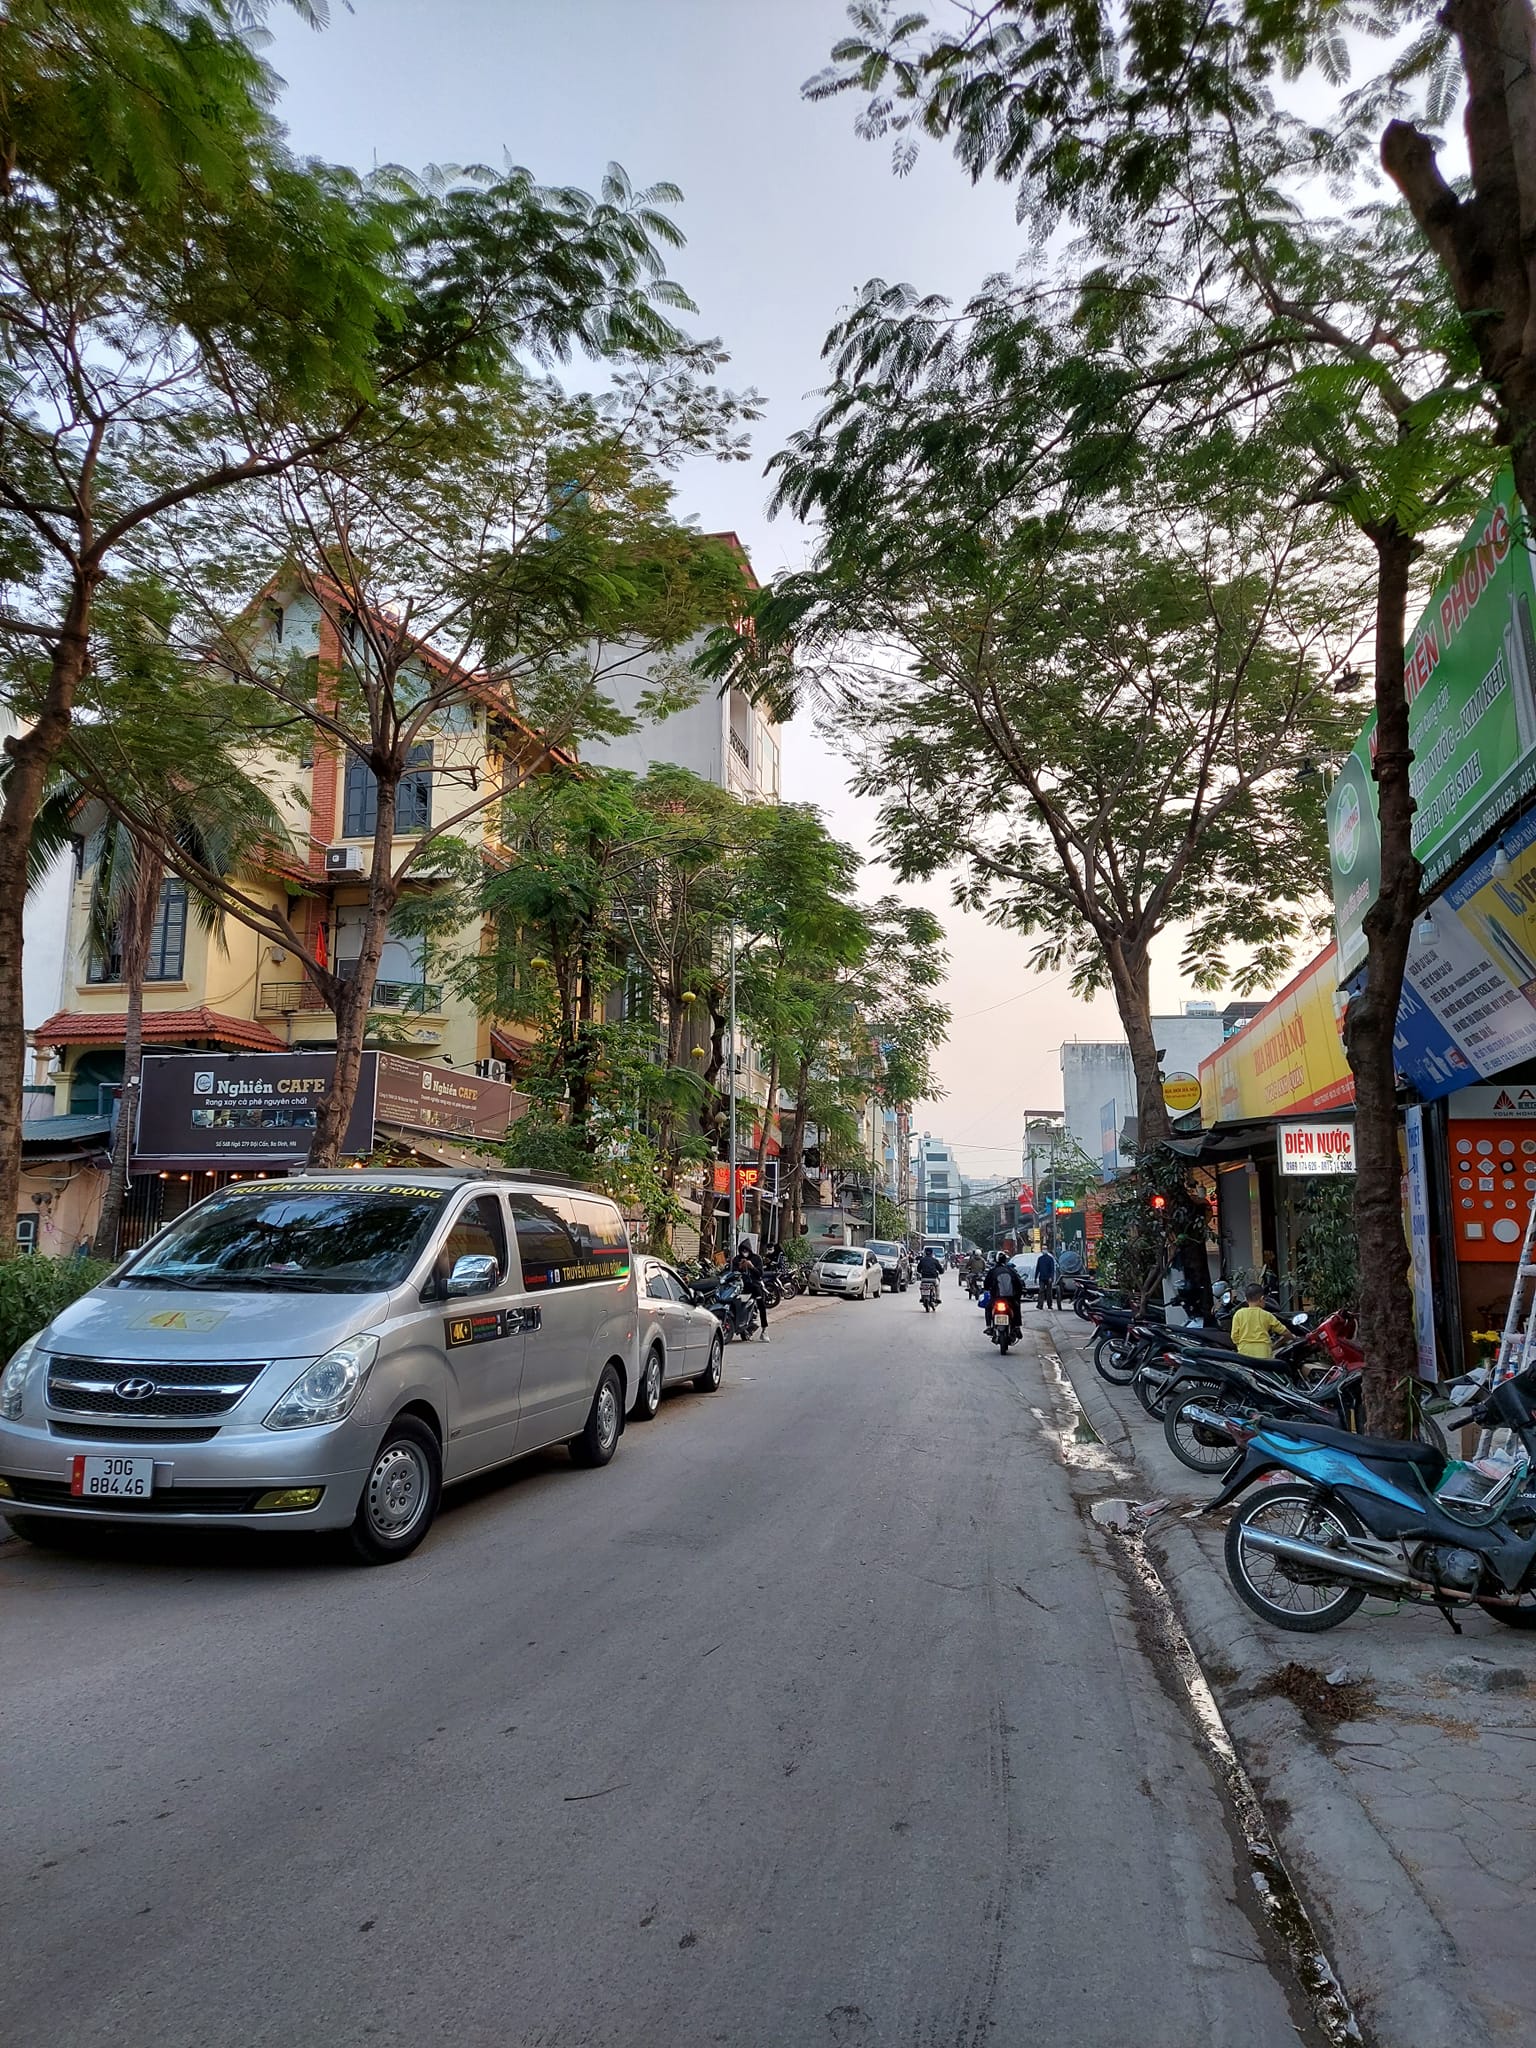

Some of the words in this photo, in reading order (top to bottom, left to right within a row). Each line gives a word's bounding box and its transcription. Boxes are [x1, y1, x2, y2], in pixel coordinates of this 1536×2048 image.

[1460, 688, 1484, 738] KIM
[1482, 647, 1506, 710] KHÍ
[1412, 796, 1432, 848] HIẾT
[1455, 750, 1483, 801] SINH
[217, 1078, 273, 1097] Nghiền
[277, 1079, 325, 1093] CAFE
[458, 1087, 478, 1100] CAFE
[249, 1098, 262, 1106] phê
[264, 1098, 290, 1106] nguyên
[291, 1096, 307, 1105] chất
[1285, 1128, 1314, 1158] ĐIỆN
[1317, 1128, 1351, 1154] NƯỚC
[226, 1182, 297, 1196] TRUYỀN
[300, 1181, 346, 1191] HÌNH
[349, 1183, 387, 1192] LƯU
[389, 1186, 443, 1199] ĐỘNG
[562, 1261, 586, 1281] TRUYỀN
[586, 1261, 599, 1277] HÌNH
[600, 1262, 610, 1276] LƯU
[104, 1459, 133, 1475] 30G
[90, 1477, 144, 1495] 884.46
